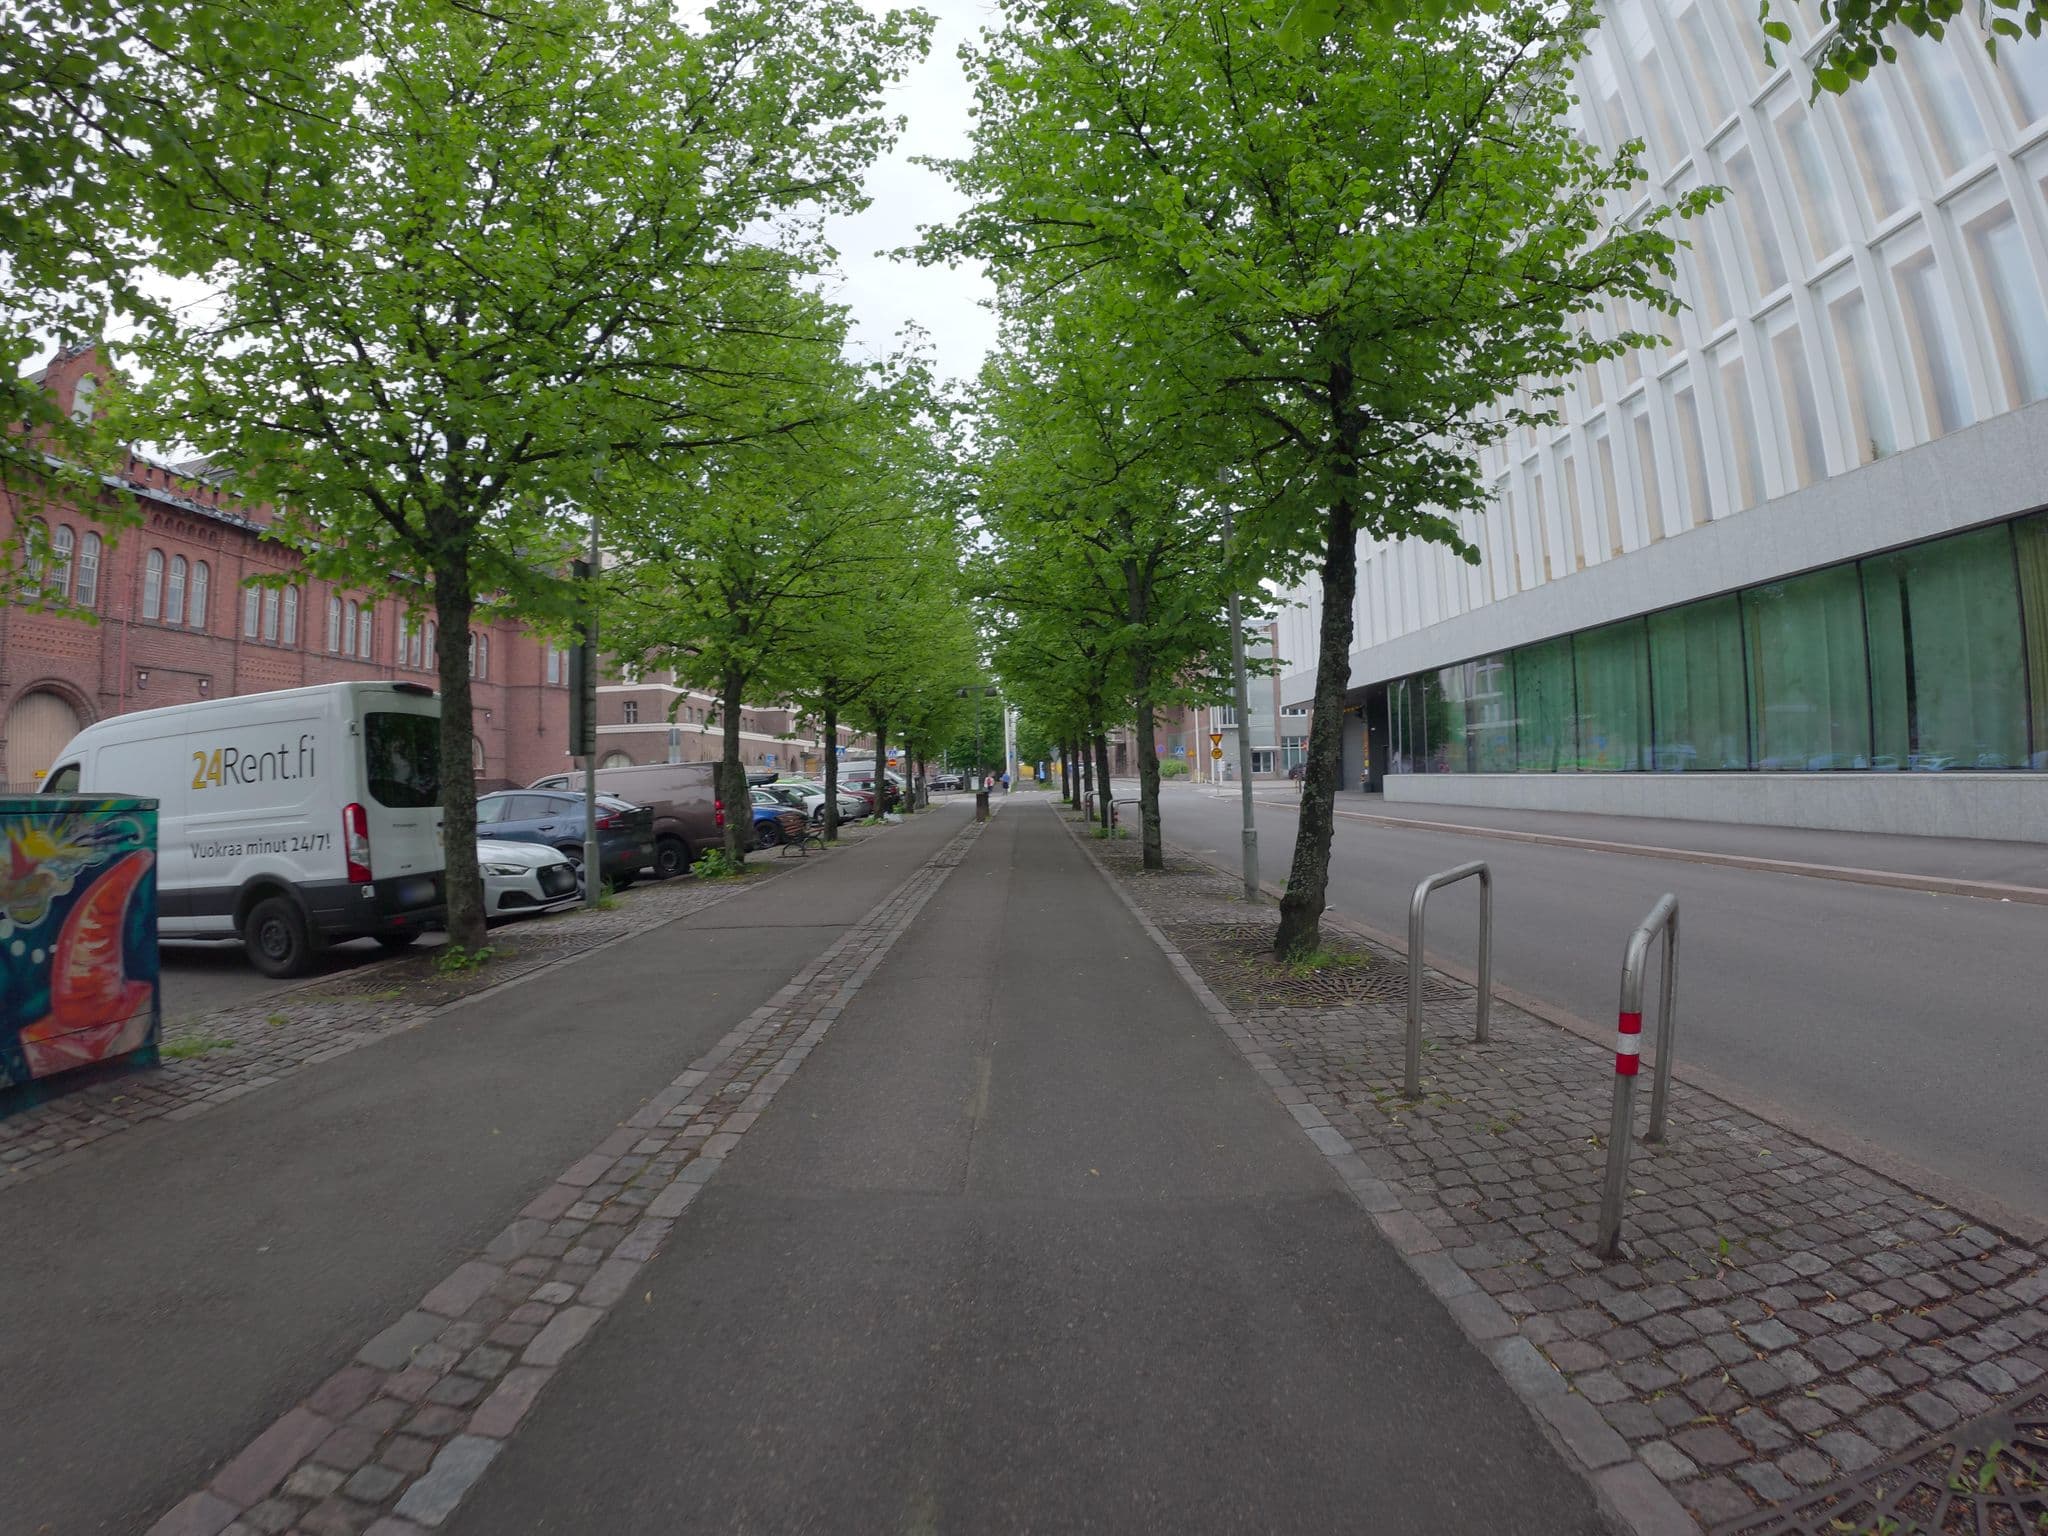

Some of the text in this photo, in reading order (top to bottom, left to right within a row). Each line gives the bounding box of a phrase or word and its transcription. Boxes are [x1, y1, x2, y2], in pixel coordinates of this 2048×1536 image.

[192, 734, 315, 790] 24Rent.fi
[191, 833, 330, 859] Vuokraa minut 24/7!
